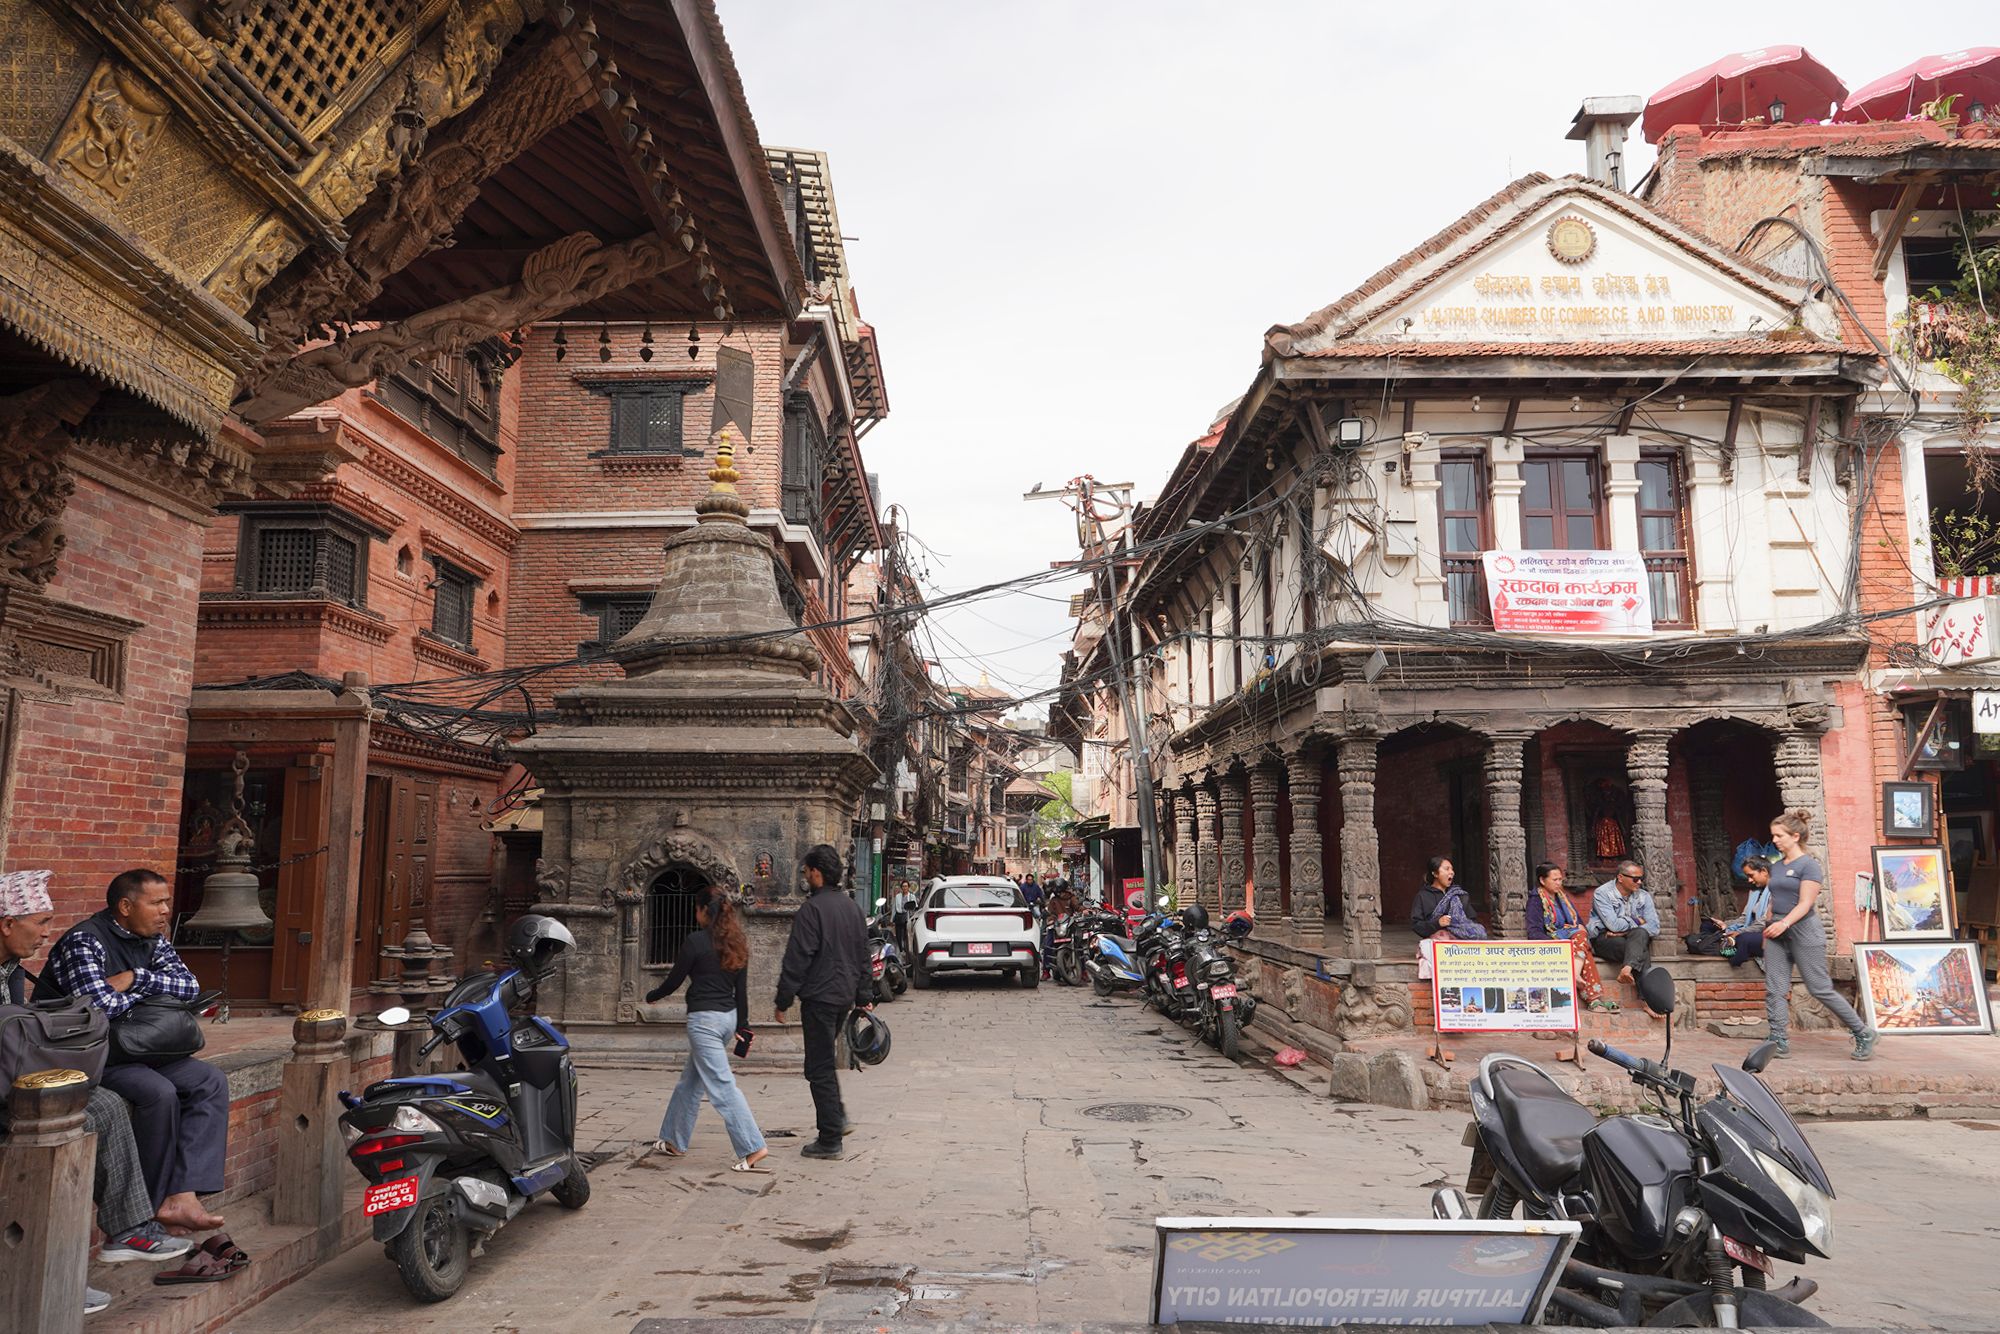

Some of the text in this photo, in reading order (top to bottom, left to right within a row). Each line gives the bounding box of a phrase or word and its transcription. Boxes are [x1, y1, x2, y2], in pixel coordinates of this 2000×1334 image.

[1481, 306, 1537, 324] CHAMBER
[1541, 306, 1556, 323] OF
[1559, 306, 1628, 324] COMMERCE
[1637, 306, 1665, 322] AND
[1673, 305, 1734, 321] INDUSTRY
[1500, 579, 1638, 596] रक्तदान कार्यक्रम
[1515, 597, 1548, 606] रक्तदान
[1961, 613, 1985, 657] Temple
[1485, 947, 1504, 955] अपर
[1508, 946, 1536, 957] मुस्ताङ
[1539, 946, 1562, 957] भ्रमण
[471, 1102, 496, 1112] Dio
